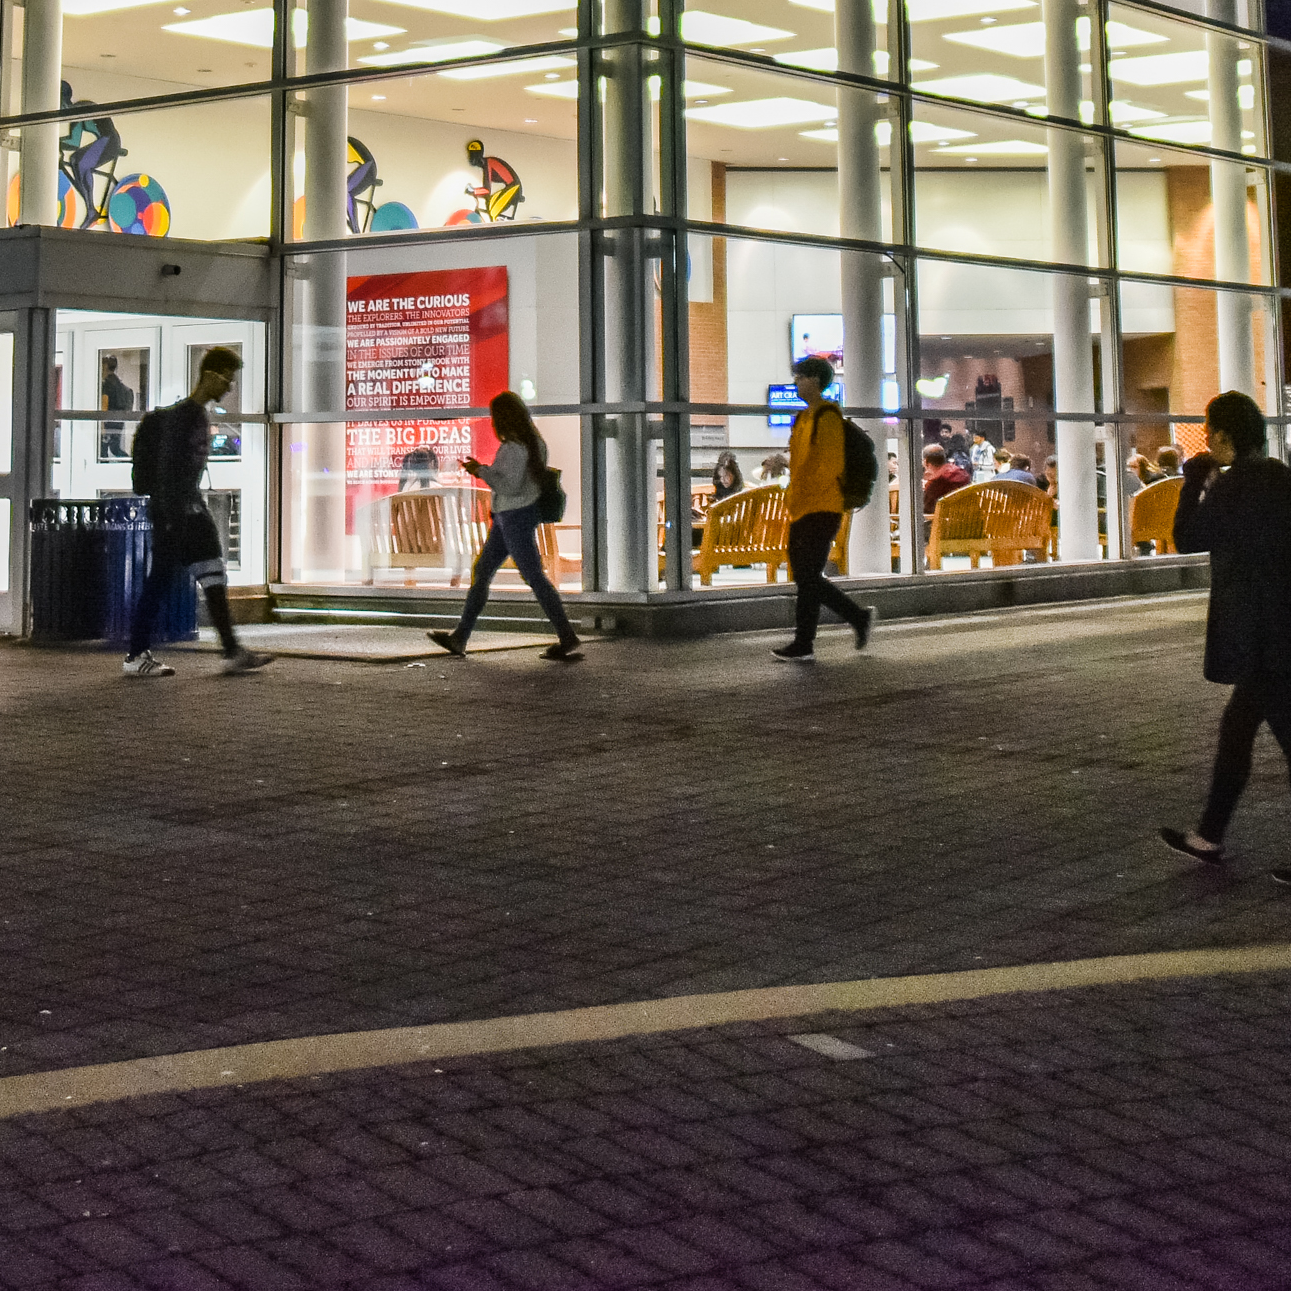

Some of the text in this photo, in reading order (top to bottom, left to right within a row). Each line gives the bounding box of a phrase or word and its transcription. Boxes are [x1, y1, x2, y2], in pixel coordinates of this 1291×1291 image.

[348, 294, 470, 313] WE ARE THE CURIOUS
[347, 314, 362, 323] THE
[405, 311, 420, 320] THE
[421, 308, 470, 319] INNOVATORS
[347, 334, 470, 348] WE ARE PASSIONATELY ENGAGED
[347, 344, 470, 360] IN THE ISSUES OF OUR TIME
[347, 361, 357, 369] WE
[358, 360, 384, 369] EMERGE
[384, 359, 404, 368] FROM
[404, 358, 426, 367] STONY
[450, 356, 470, 364] WITH
[347, 366, 470, 381] THE MOMENTUM TO MAKE
[347, 383, 356, 396] A
[358, 381, 391, 396] REAL
[771, 391, 797, 399] ART CRA
[346, 394, 470, 408] OUR SPIRIT IS EMPOWERED
[346, 425, 471, 446] THE BIG IDEAS
[347, 447, 365, 456] THAT
[368, 447, 387, 456] WILL
[432, 446, 449, 455] OUR
[450, 445, 471, 454] LIVES
[347, 457, 368, 469] AND
[370, 456, 403, 468] IMPAC
[347, 469, 399, 478] WE ARE STONY
